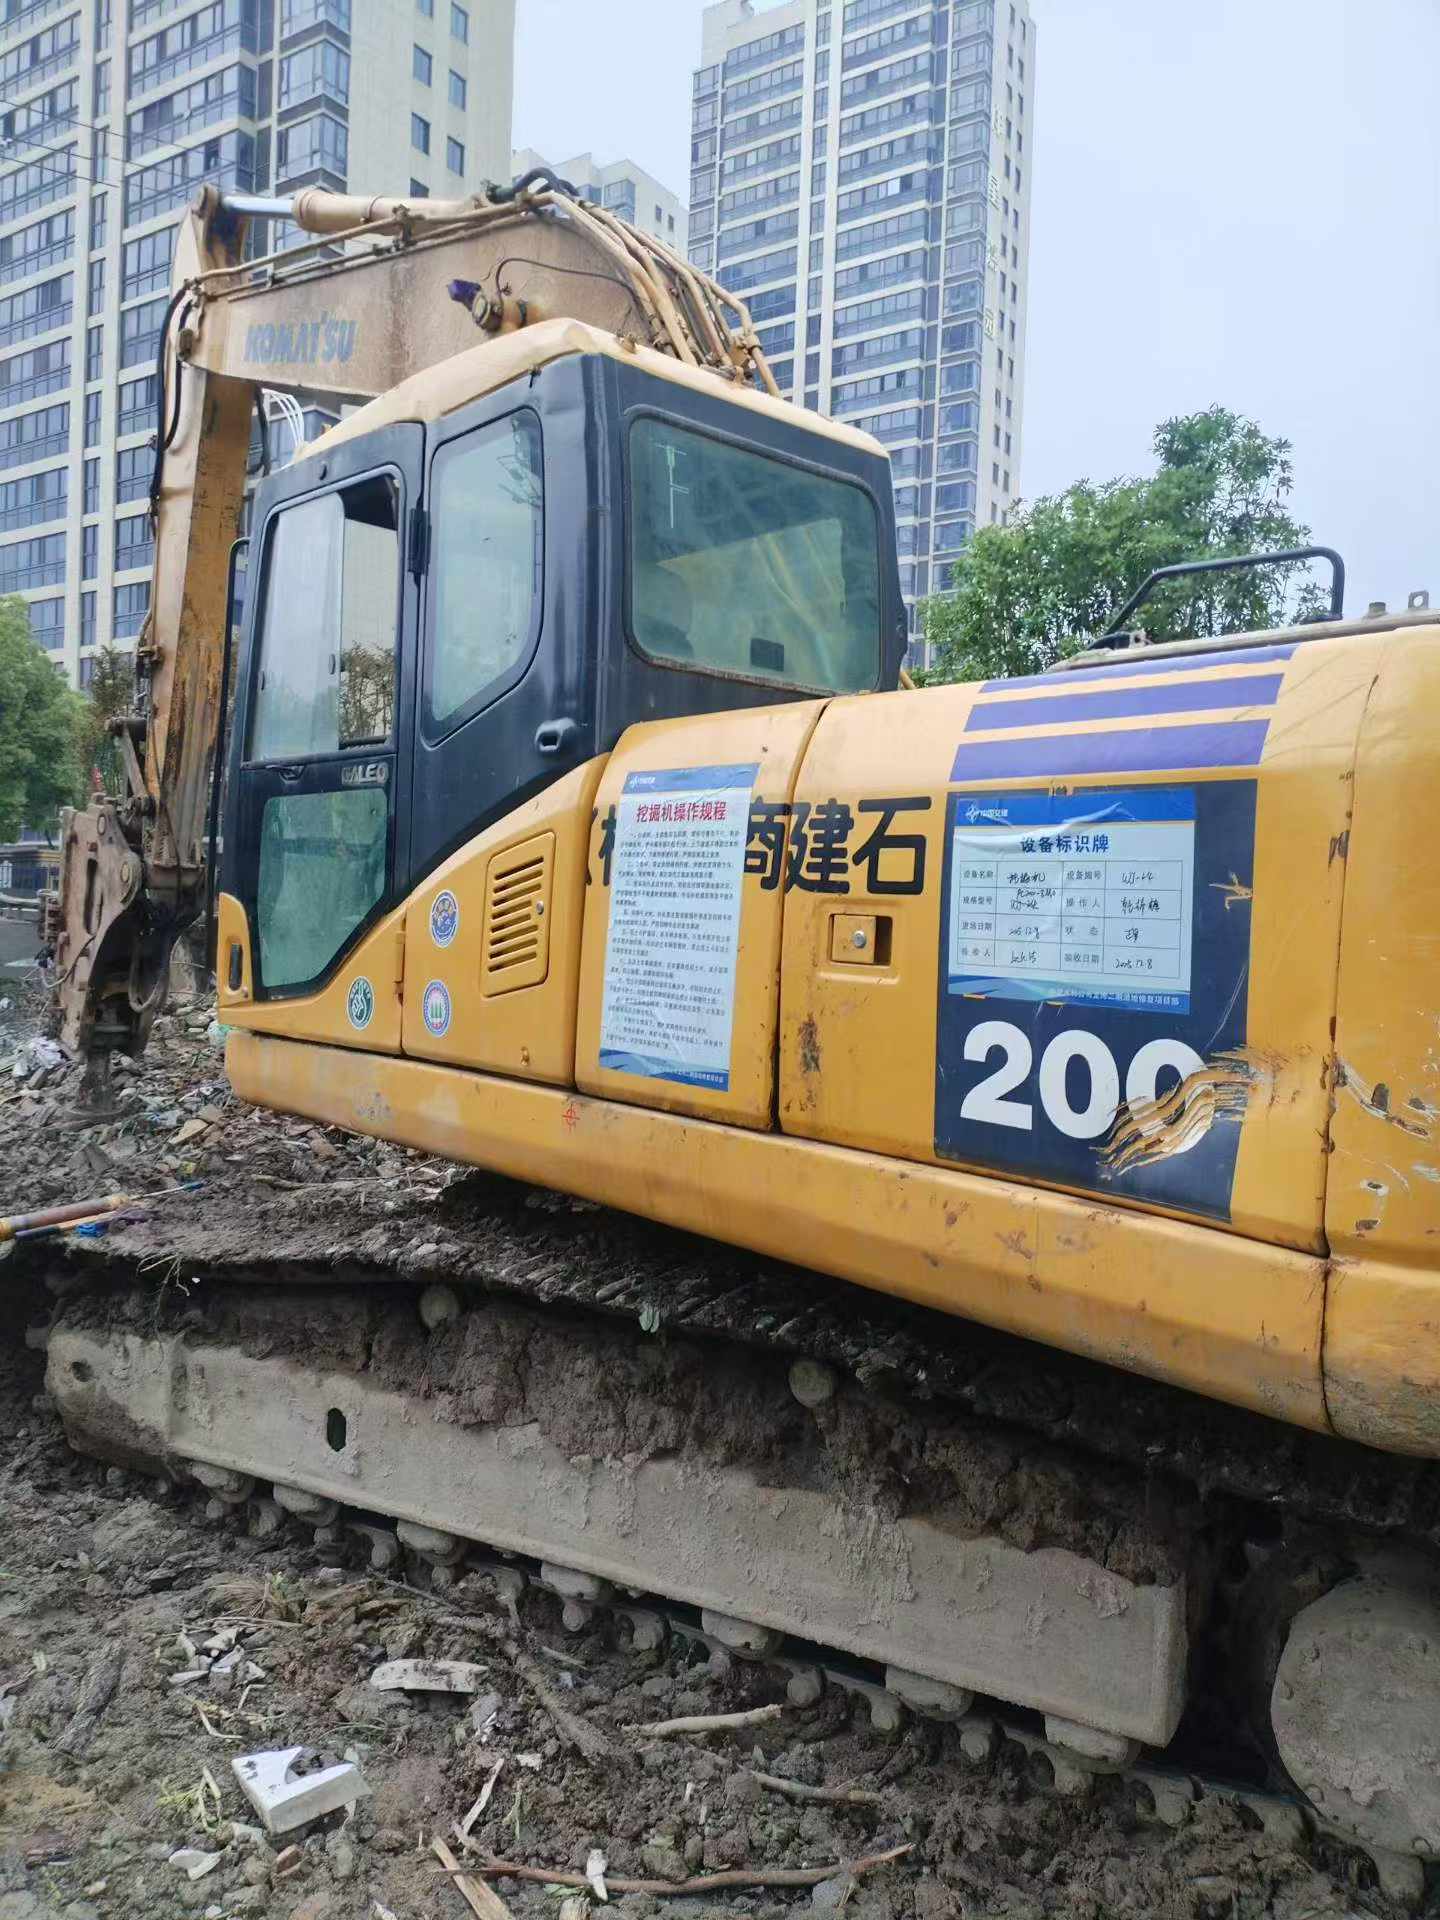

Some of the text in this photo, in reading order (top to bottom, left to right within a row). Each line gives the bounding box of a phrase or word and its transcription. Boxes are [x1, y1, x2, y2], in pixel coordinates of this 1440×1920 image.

[243, 312, 358, 366] KOMATSU
[636, 801, 727, 823] 挖掘机操作规程
[1020, 833, 1111, 854] 设备标识牌
[1066, 869, 1102, 880] 设备编号
[962, 896, 993, 905] 规格型号
[960, 1020, 1213, 1156] 200
